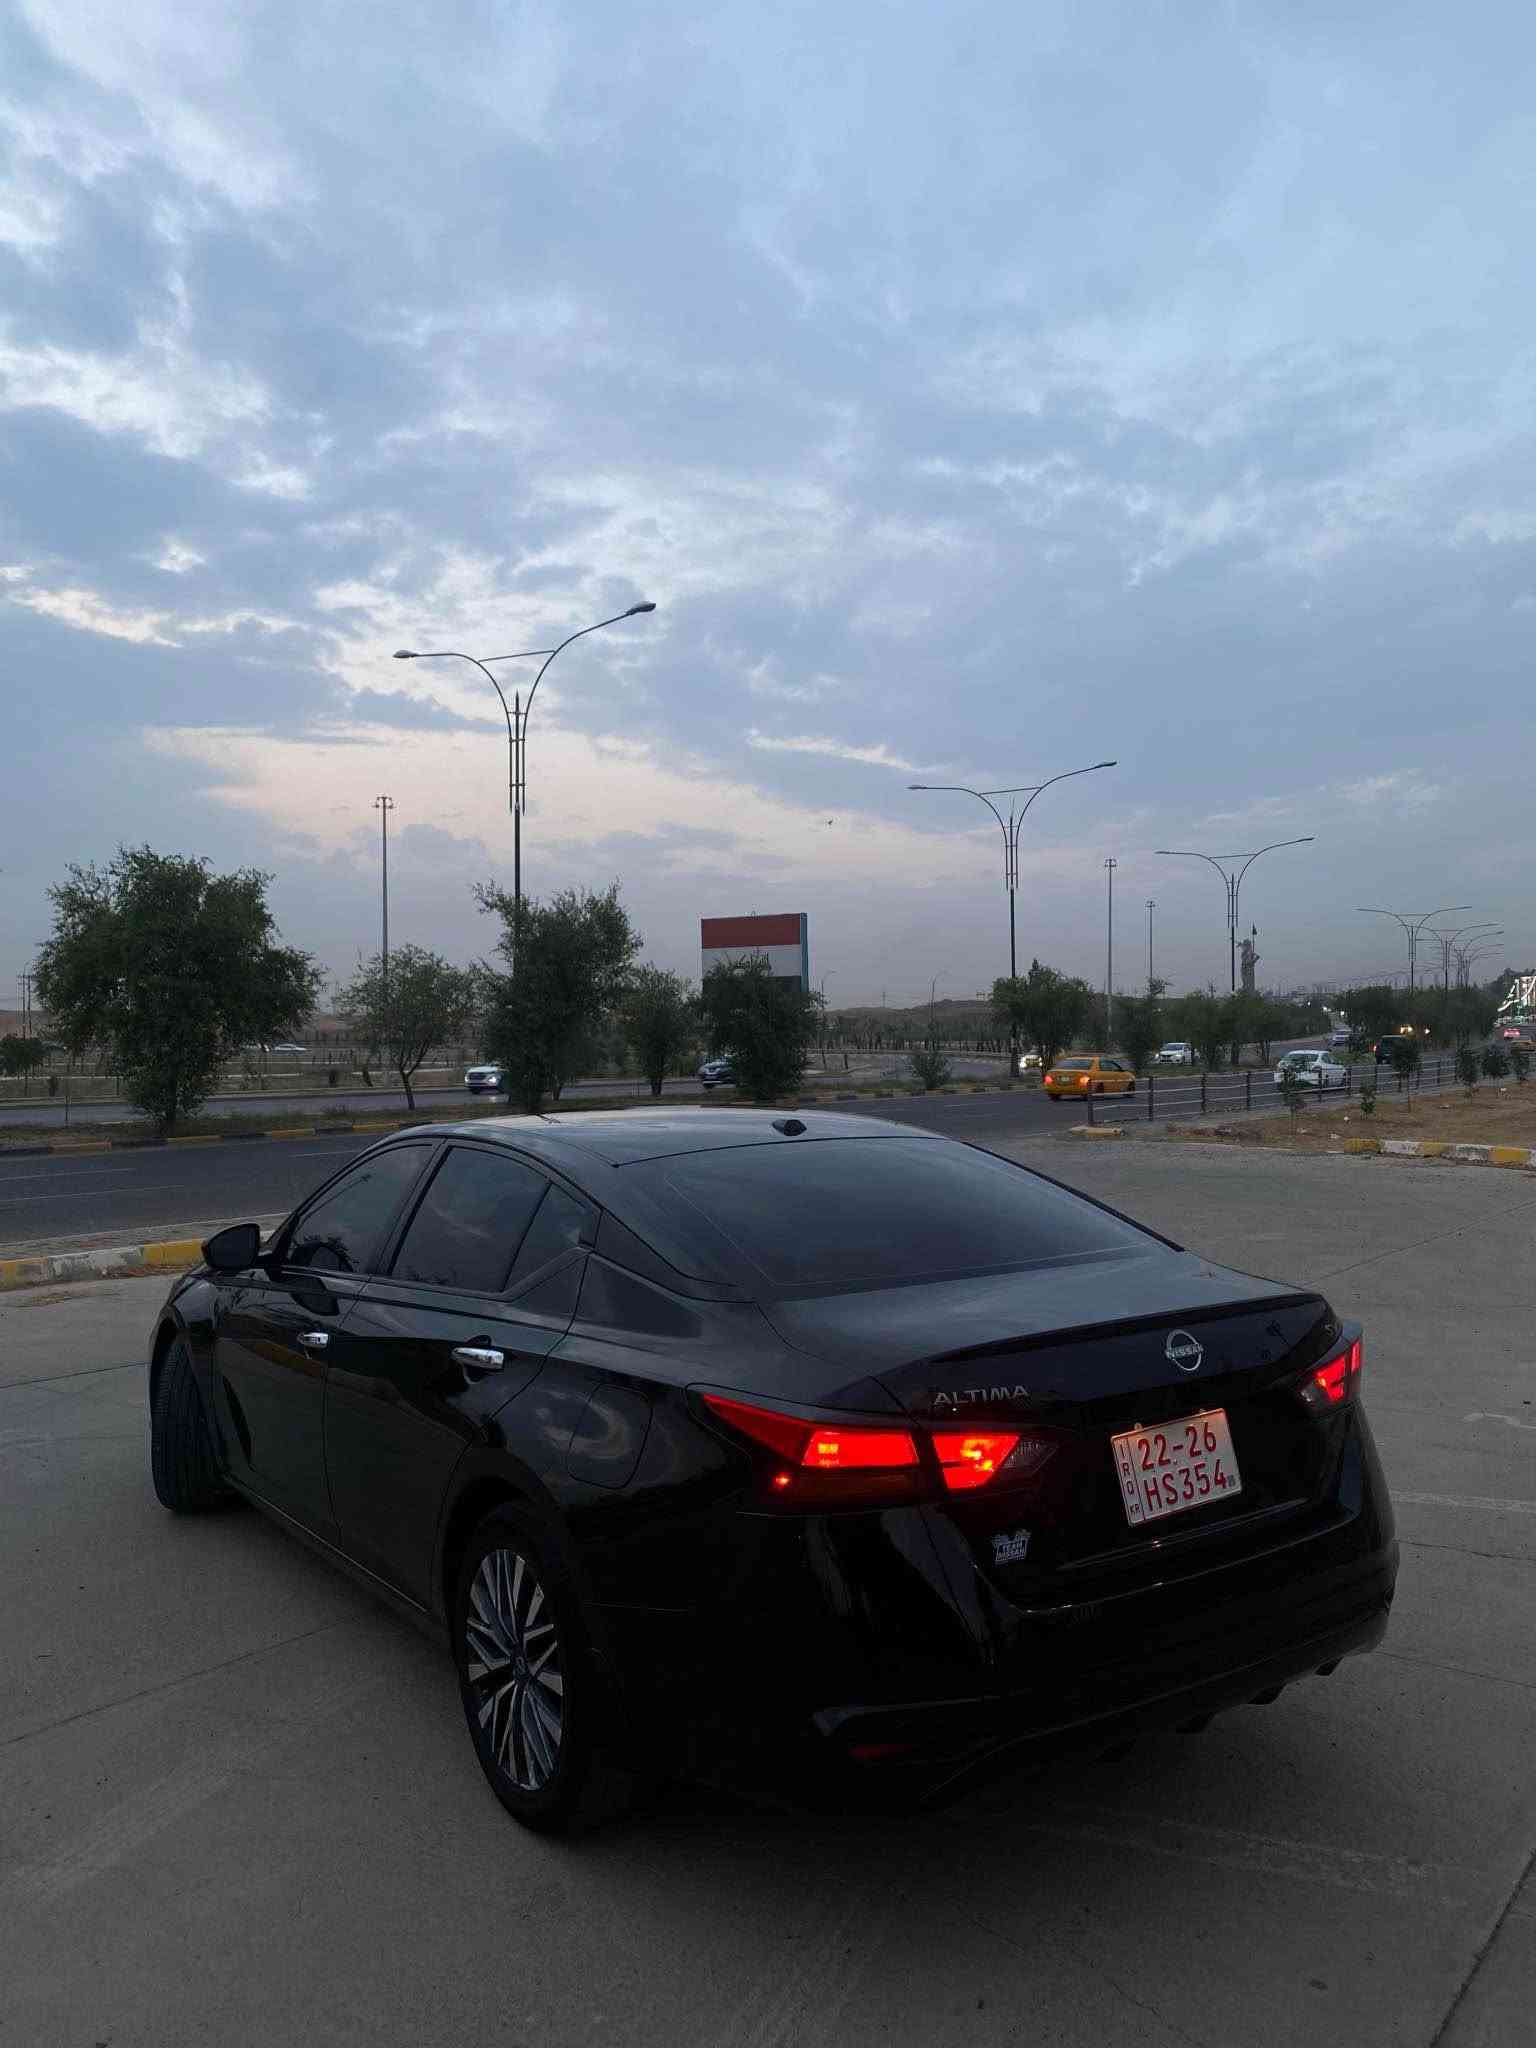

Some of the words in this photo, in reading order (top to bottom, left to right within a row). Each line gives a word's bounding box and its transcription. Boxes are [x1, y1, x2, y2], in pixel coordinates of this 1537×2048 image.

[1165, 1344, 1204, 1360] NISSAN
[934, 1385, 1031, 1405] ALTIMA
[1137, 1421, 1217, 1472] 22-26
[1144, 1459, 1227, 1512] HS354
